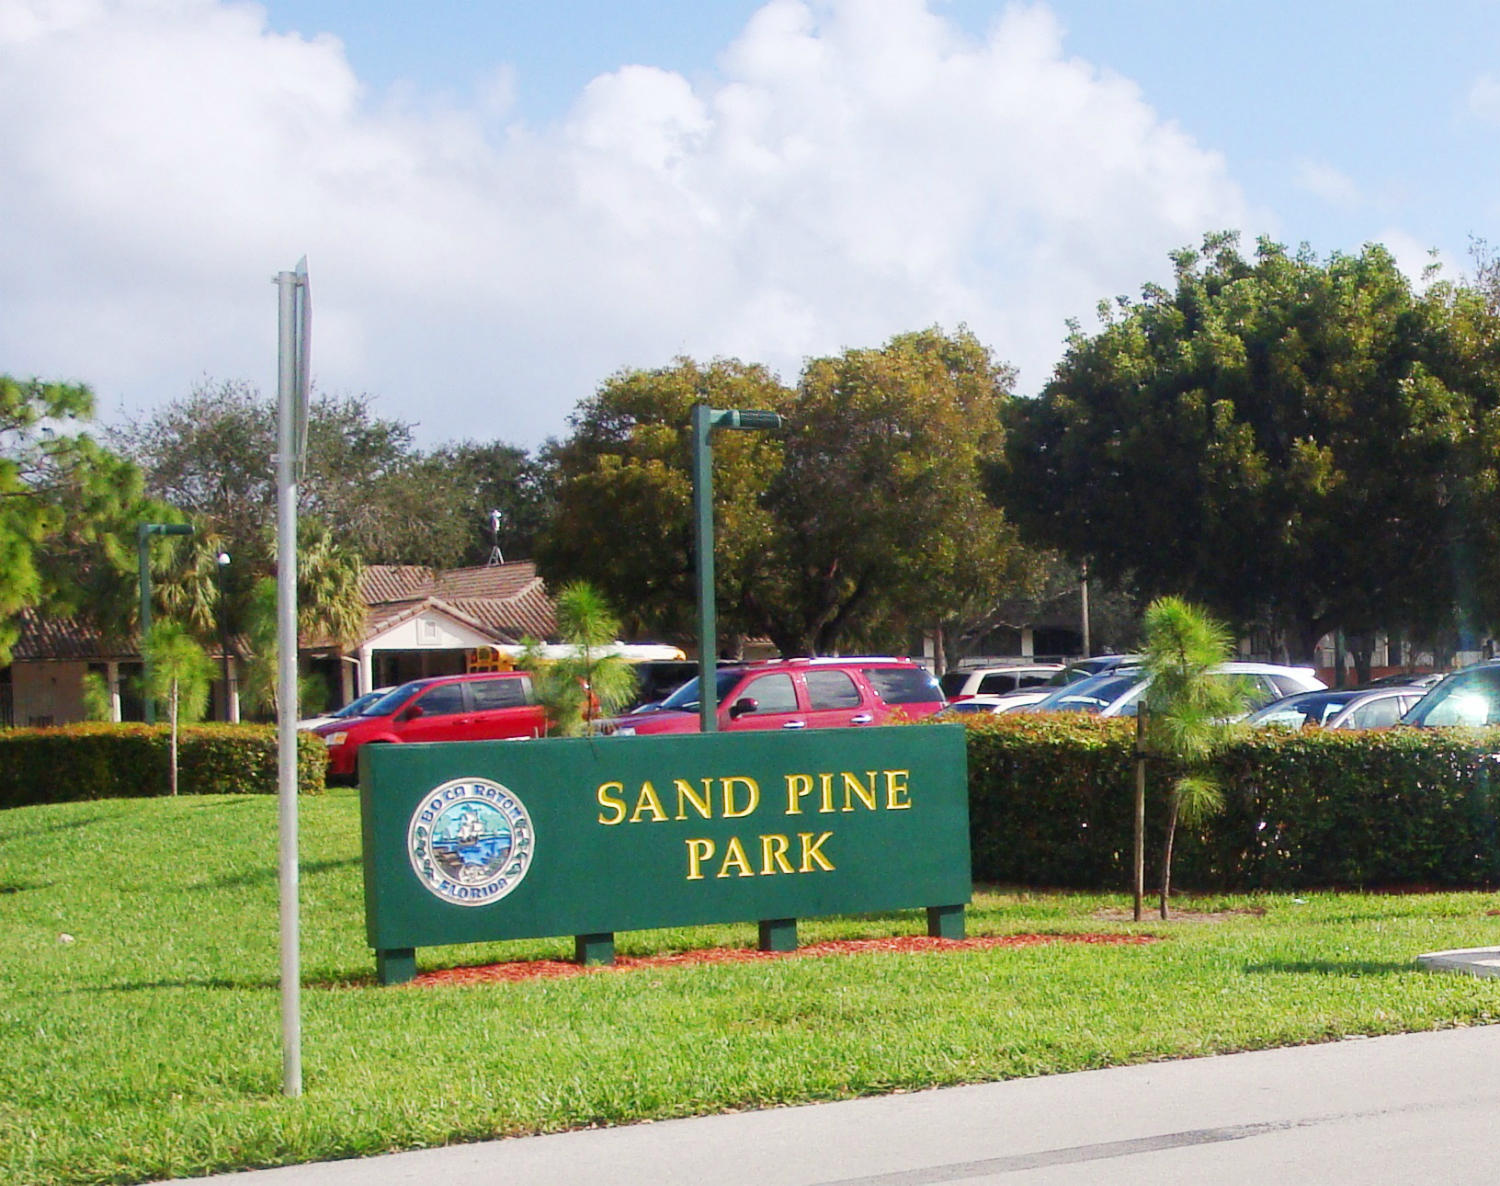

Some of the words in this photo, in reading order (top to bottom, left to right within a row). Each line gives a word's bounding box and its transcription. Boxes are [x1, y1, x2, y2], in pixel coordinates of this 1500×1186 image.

[421, 786, 466, 822] BOCA
[473, 784, 522, 819] RATON
[597, 775, 760, 825] SAND
[784, 769, 912, 815] PINE
[685, 831, 836, 880] PARK
[439, 878, 508, 898] FLORIDA
